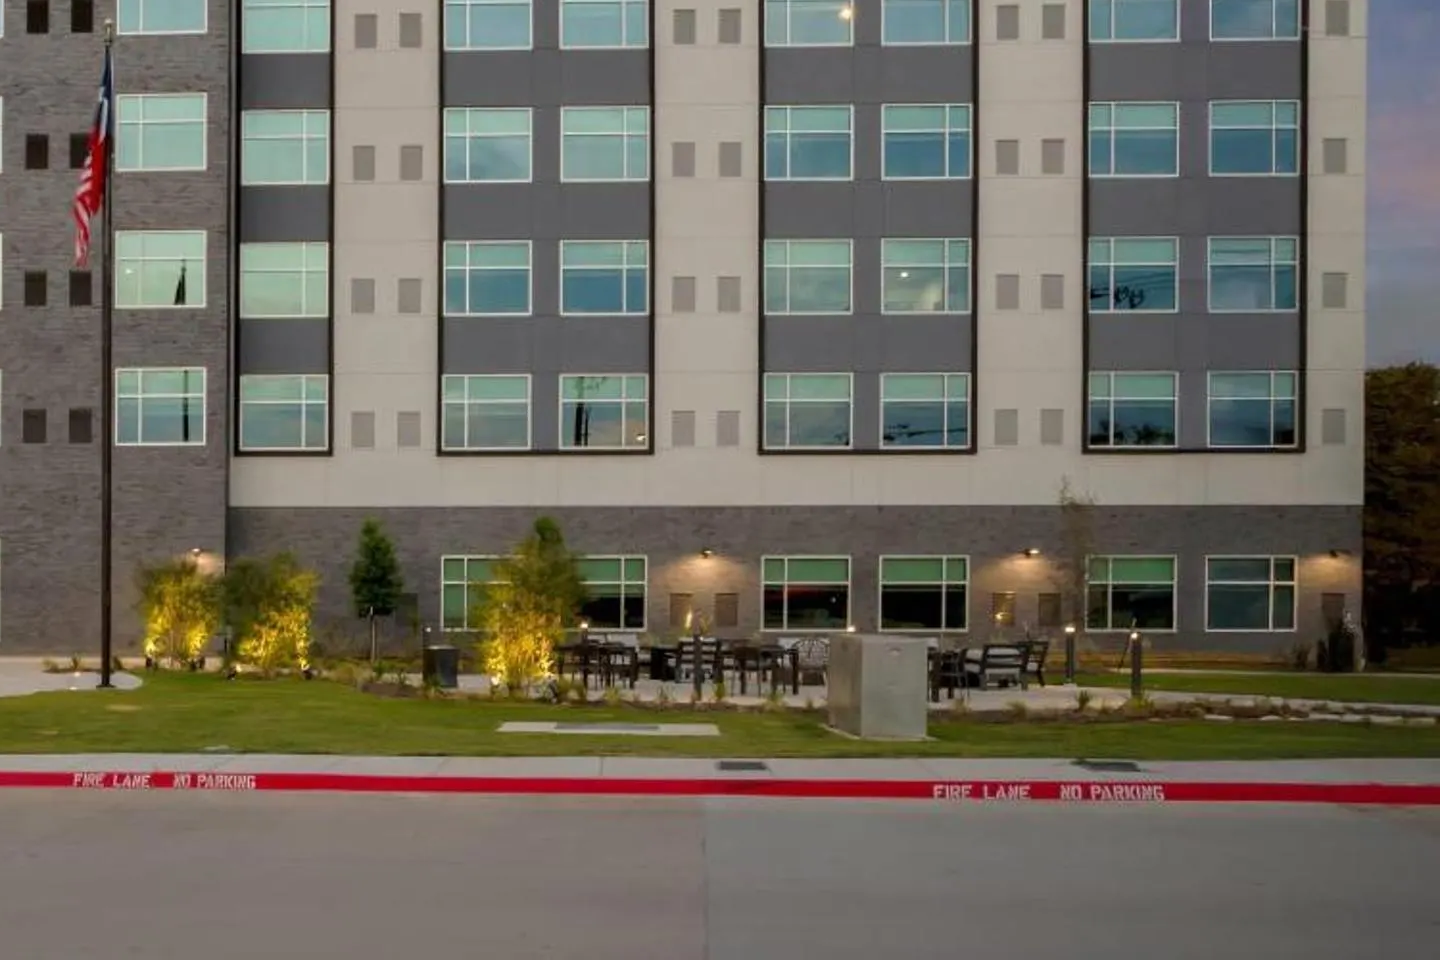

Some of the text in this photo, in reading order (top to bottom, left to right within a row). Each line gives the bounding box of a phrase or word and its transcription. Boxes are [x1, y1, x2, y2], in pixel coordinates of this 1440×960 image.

[73, 772, 257, 790] FIRE LANE NO PARKING
[933, 784, 1165, 801] FIRE LANE NO PARKING
